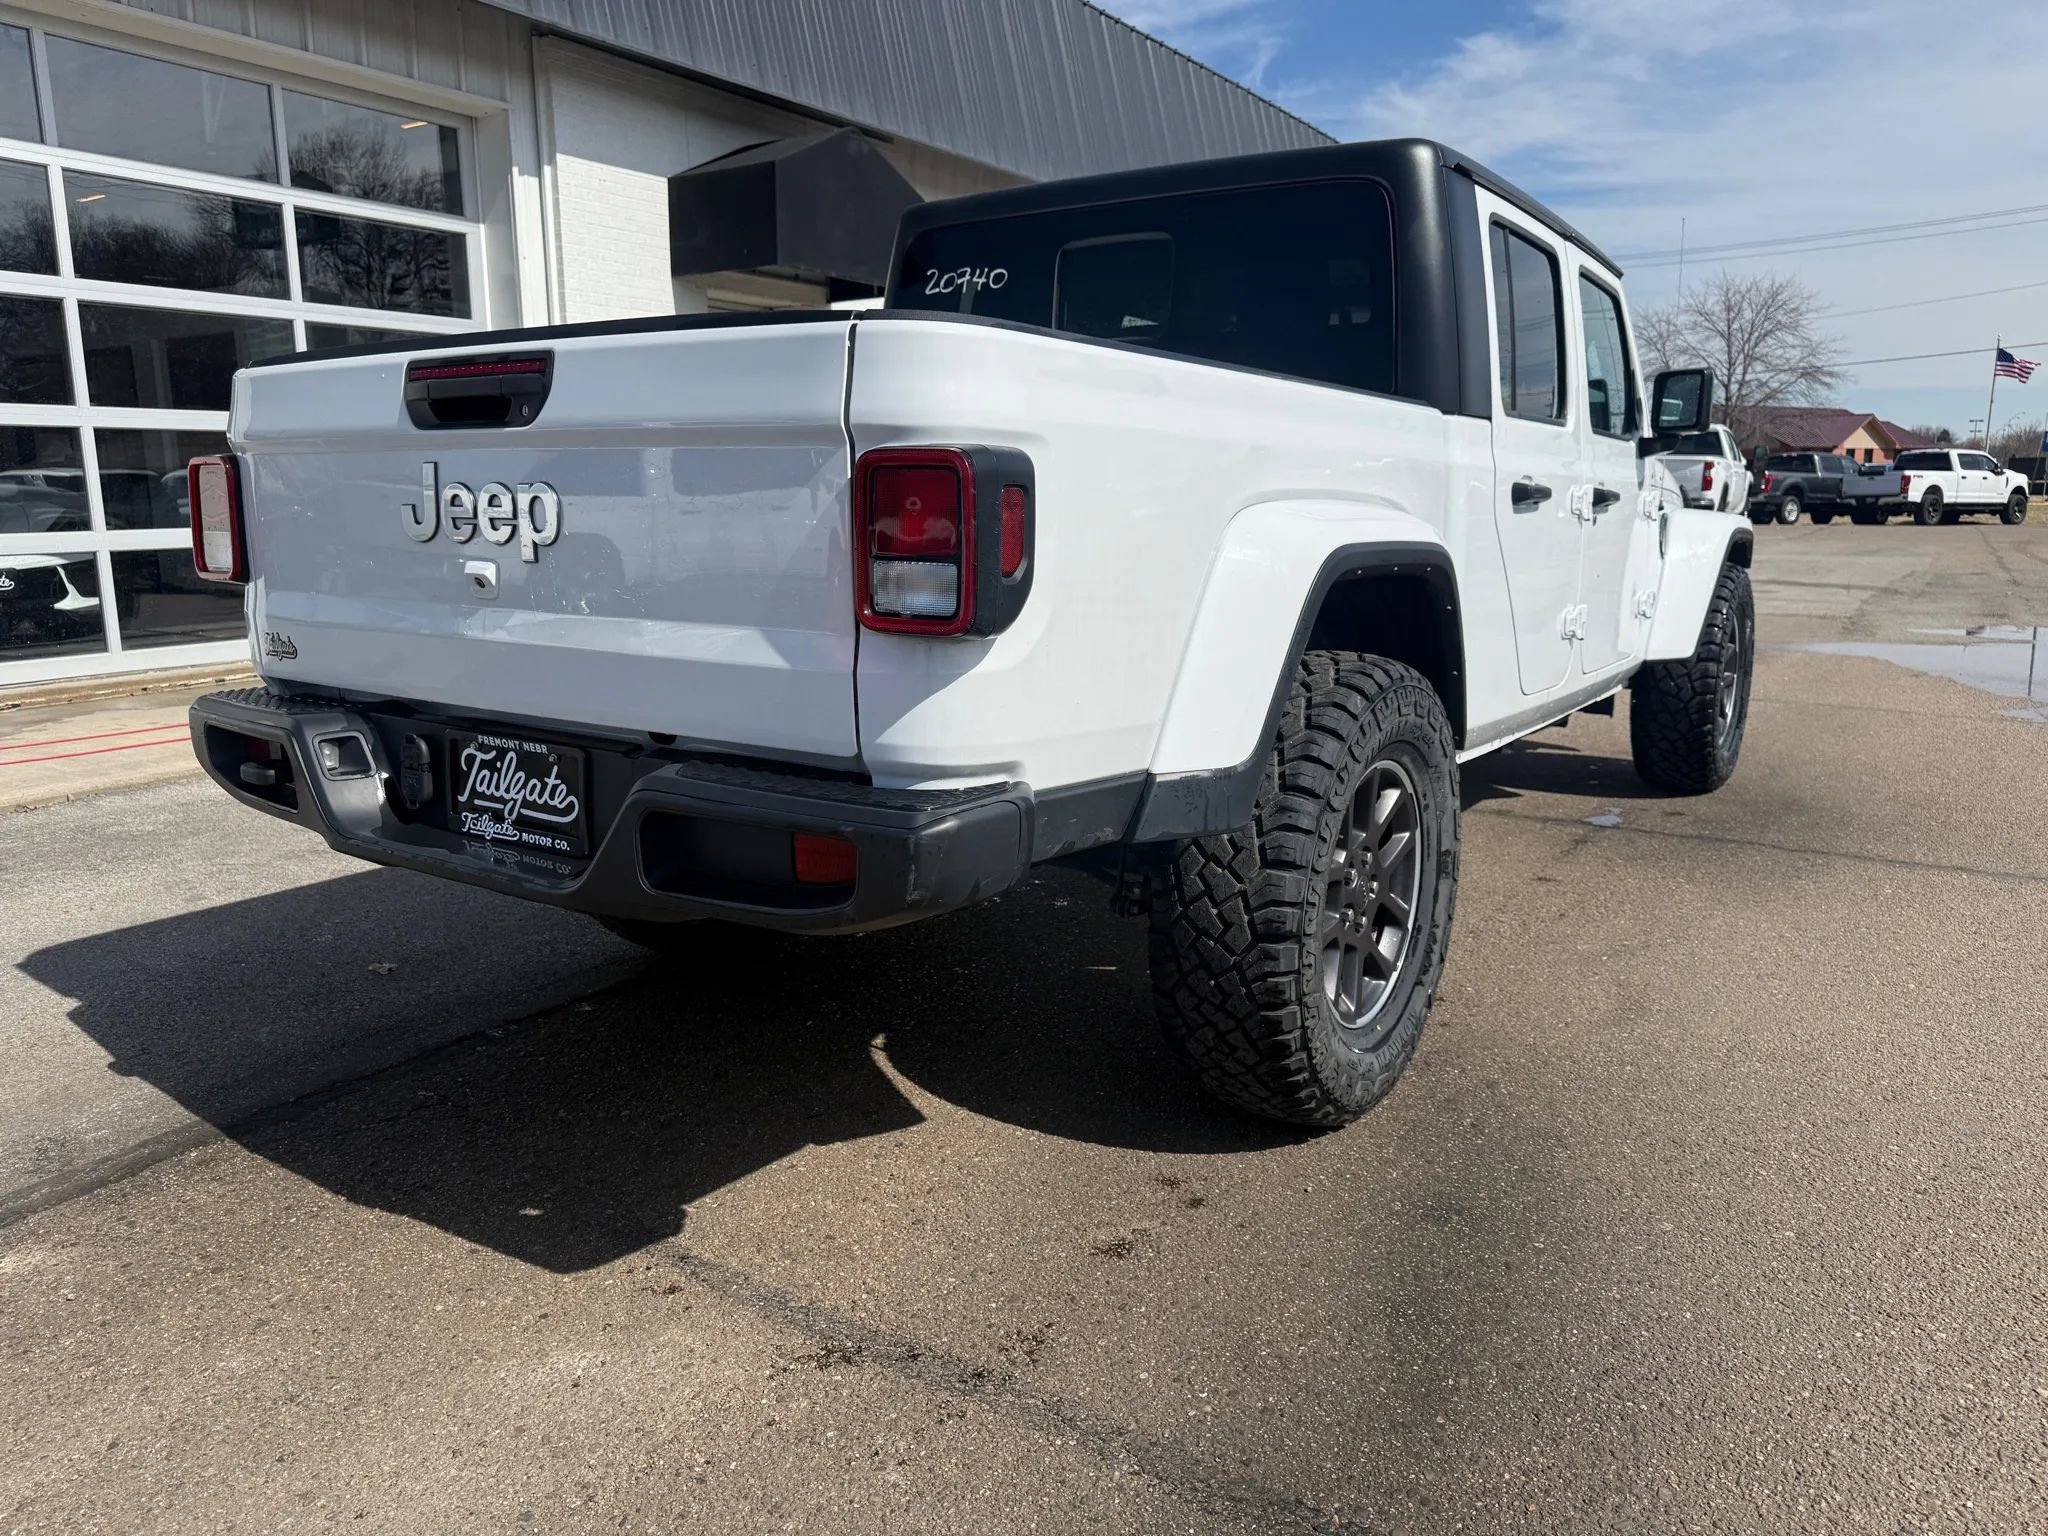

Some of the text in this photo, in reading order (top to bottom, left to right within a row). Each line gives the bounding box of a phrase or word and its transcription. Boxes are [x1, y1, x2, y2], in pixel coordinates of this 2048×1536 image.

[925, 267, 1008, 295] 20740
[401, 461, 562, 563] Jeep
[477, 735, 548, 755] FREMONT NEBR
[458, 748, 579, 823] Tailgate
[461, 812, 570, 851] Tailgate MOTOR CO.
